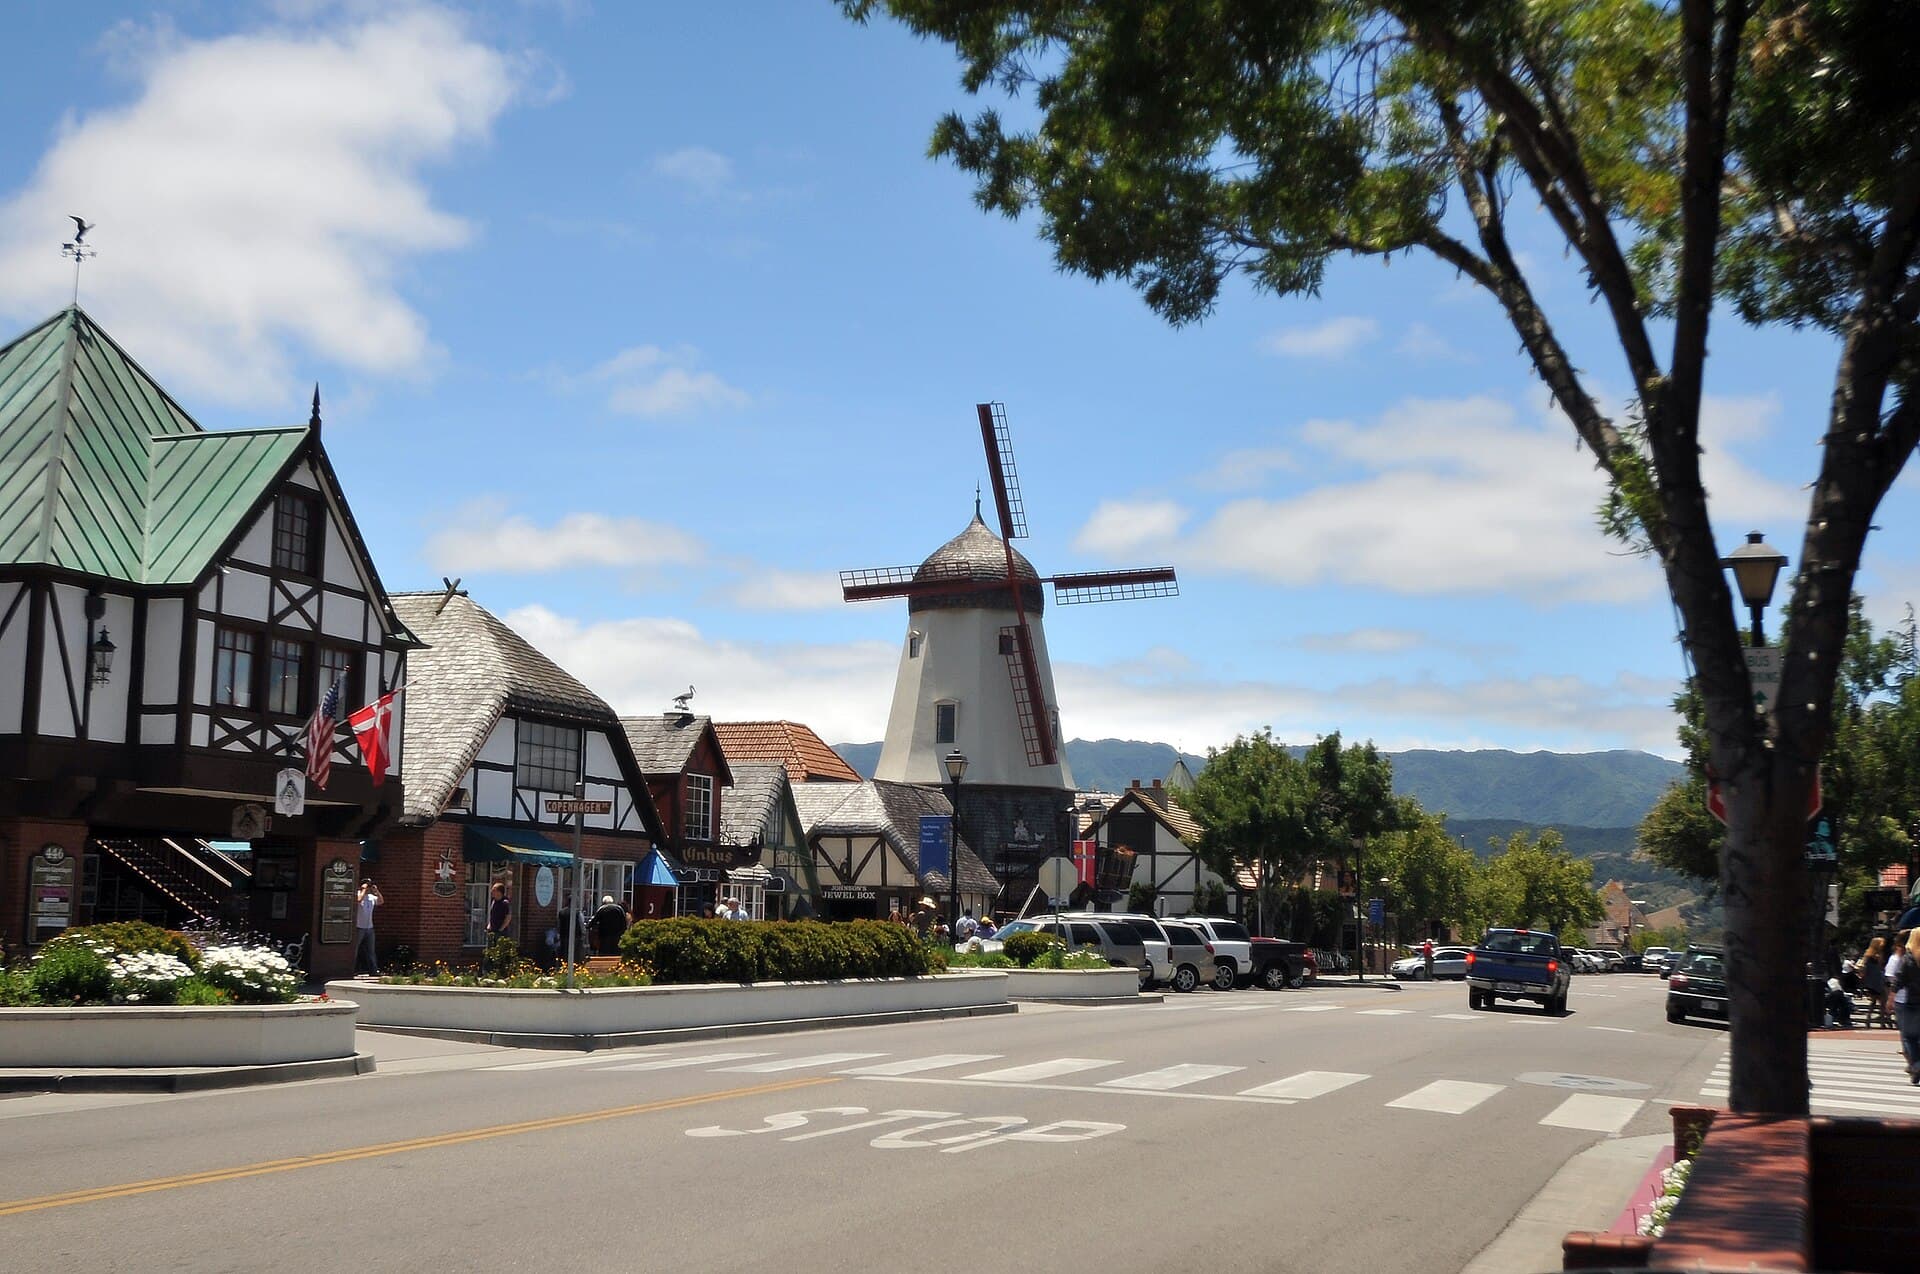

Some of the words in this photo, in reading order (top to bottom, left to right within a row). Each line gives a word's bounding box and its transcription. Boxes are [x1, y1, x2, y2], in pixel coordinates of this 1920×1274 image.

[1746, 655, 1769, 667] BUS
[546, 801, 600, 813] COPENHAGEN
[45, 847, 64, 860] 446
[333, 862, 347, 873] 446
[822, 891, 854, 899] JEWEL
[857, 891, 876, 899] BOX
[685, 1106, 1128, 1153] STOP
